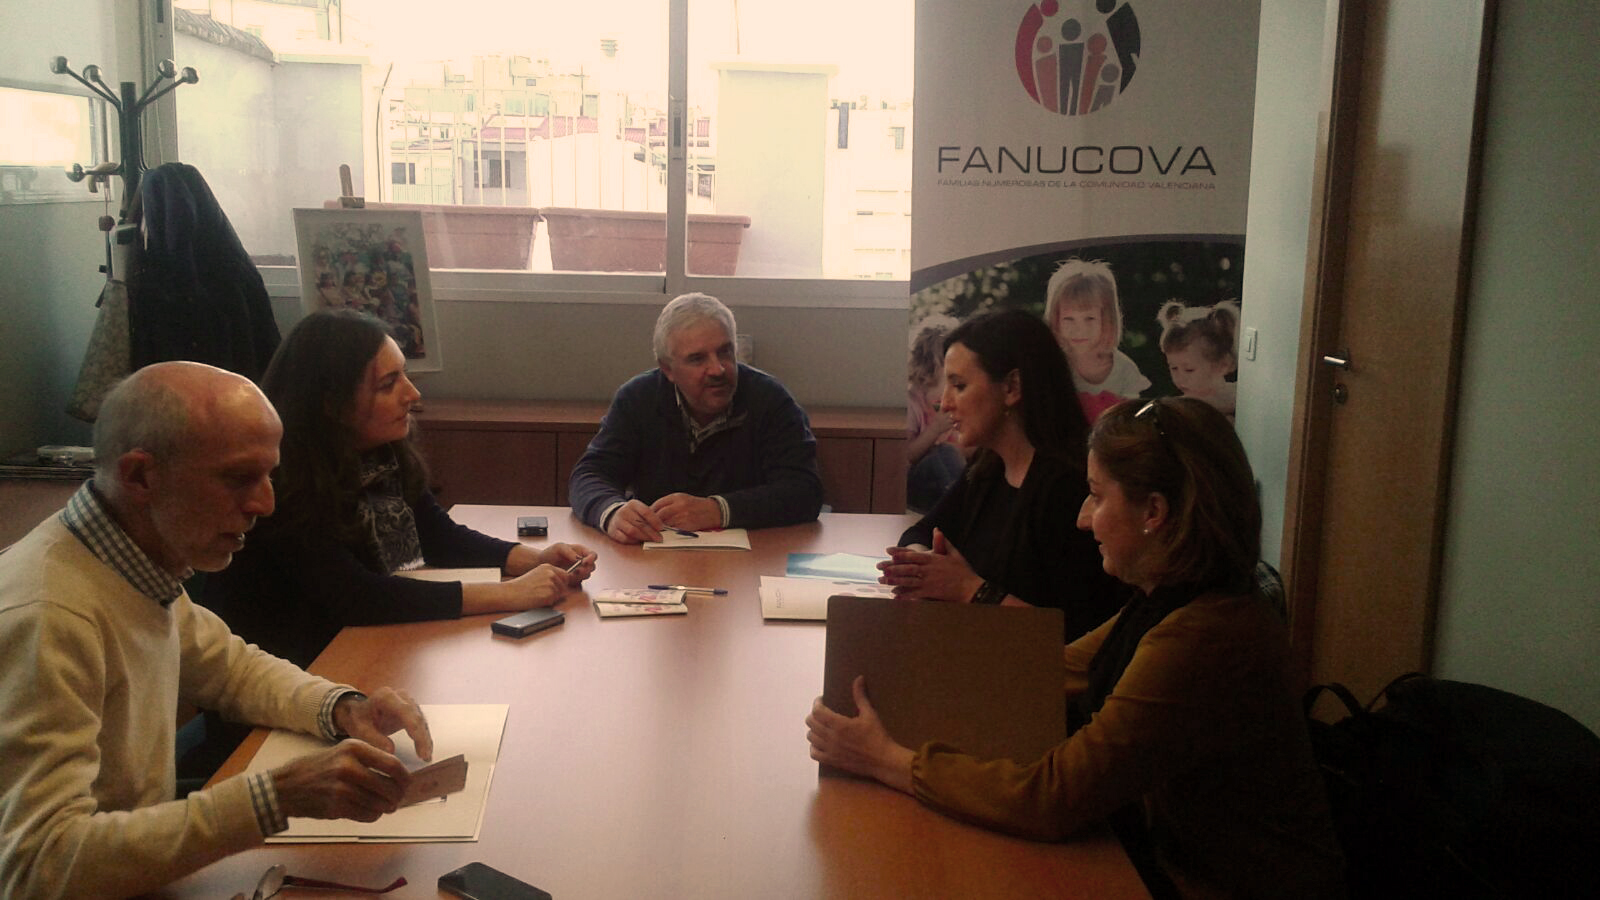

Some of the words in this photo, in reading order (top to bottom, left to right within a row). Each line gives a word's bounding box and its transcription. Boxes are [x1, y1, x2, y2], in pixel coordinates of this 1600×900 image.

[938, 146, 1216, 175] FANUCOVA
[1047, 180, 1061, 188] DE
[1079, 181, 1145, 189] COMUNIDAD
[1149, 182, 1216, 190] VALENCIANA
